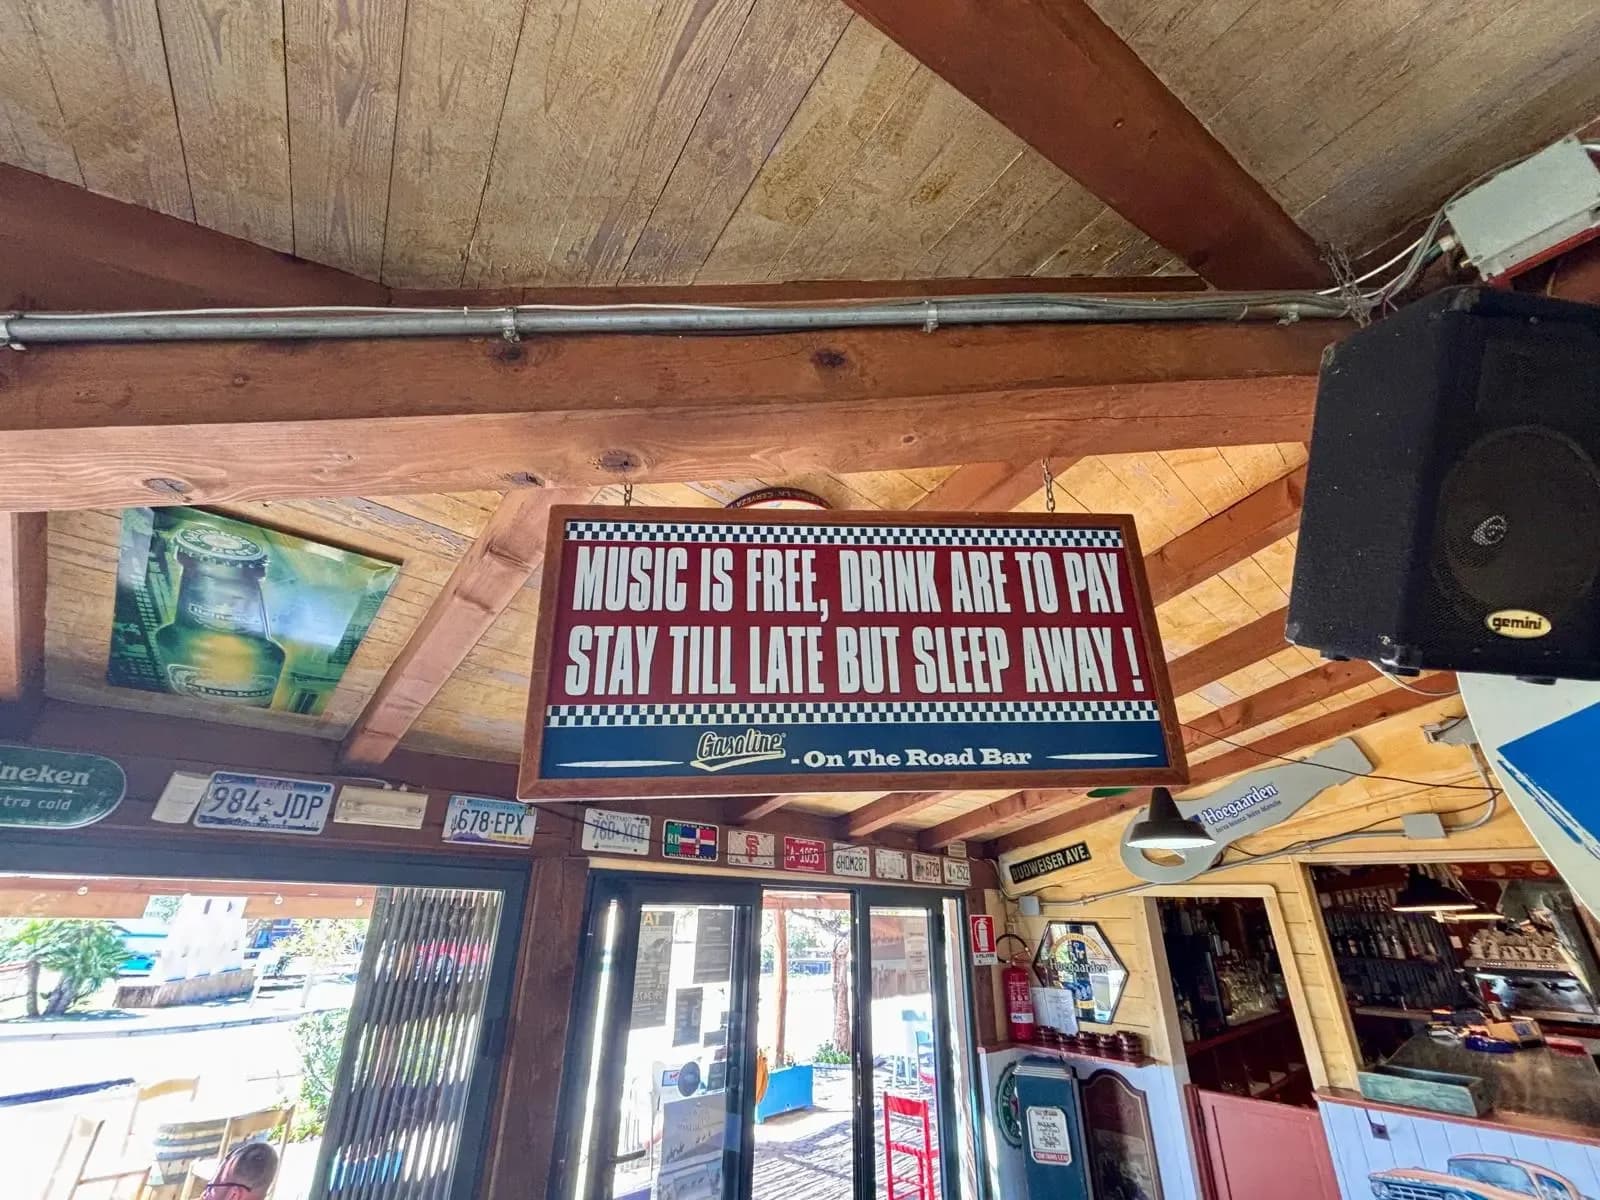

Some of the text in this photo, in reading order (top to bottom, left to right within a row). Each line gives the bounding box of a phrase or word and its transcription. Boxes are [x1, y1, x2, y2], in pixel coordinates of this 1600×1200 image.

[572, 546, 1125, 623] MUSIC IS FREE, DRINK ARE TO PAY
[1492, 616, 1542, 631] gemini
[564, 625, 659, 697] STAY
[669, 625, 737, 696] TILL
[749, 626, 825, 694] LATE
[835, 626, 901, 694] BUT
[911, 626, 1010, 694] SLEEP
[696, 728, 784, 761] Gasoline
[803, 750, 845, 768] On
[848, 749, 901, 767] The
[904, 748, 977, 767] Road
[979, 748, 1032, 765] Bar
[0, 763, 91, 787] neken
[0, 795, 73, 812] tra cold
[1202, 783, 1279, 826] Hoegaarden
[667, 833, 681, 845] RD
[1010, 844, 1090, 882] BUDWEISER AVE.
